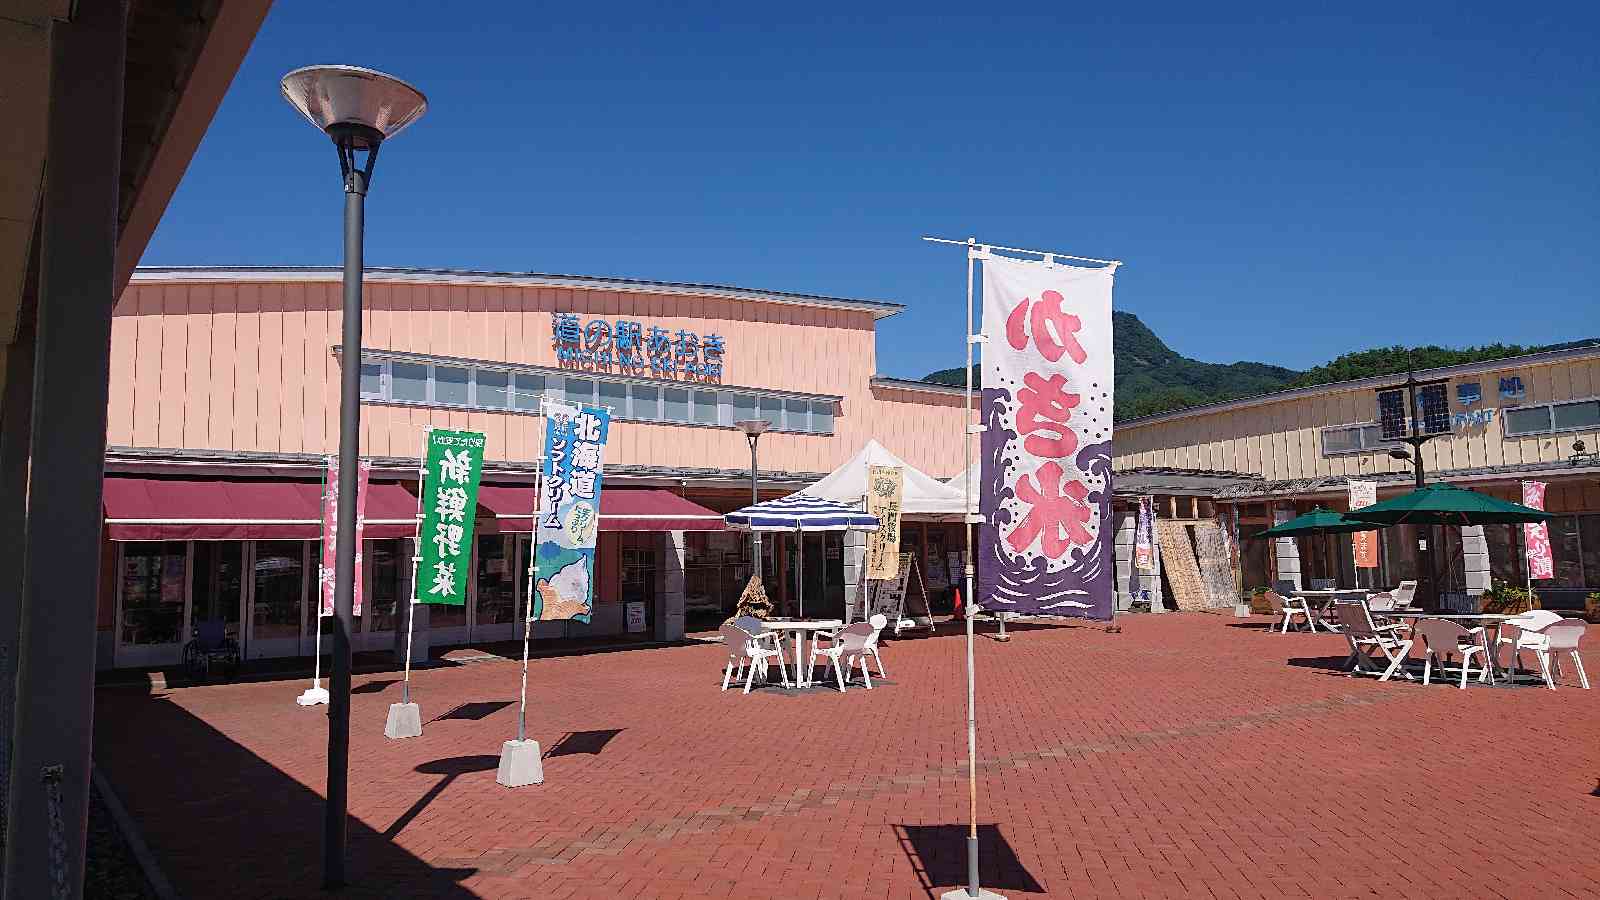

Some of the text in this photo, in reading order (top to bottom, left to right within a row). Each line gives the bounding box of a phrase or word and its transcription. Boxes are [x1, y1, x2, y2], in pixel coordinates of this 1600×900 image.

[552, 313, 725, 357] 道の駅あおき
[619, 351, 645, 369] NO
[544, 437, 567, 529] ソフトクリーム
[568, 411, 602, 499] 北海道
